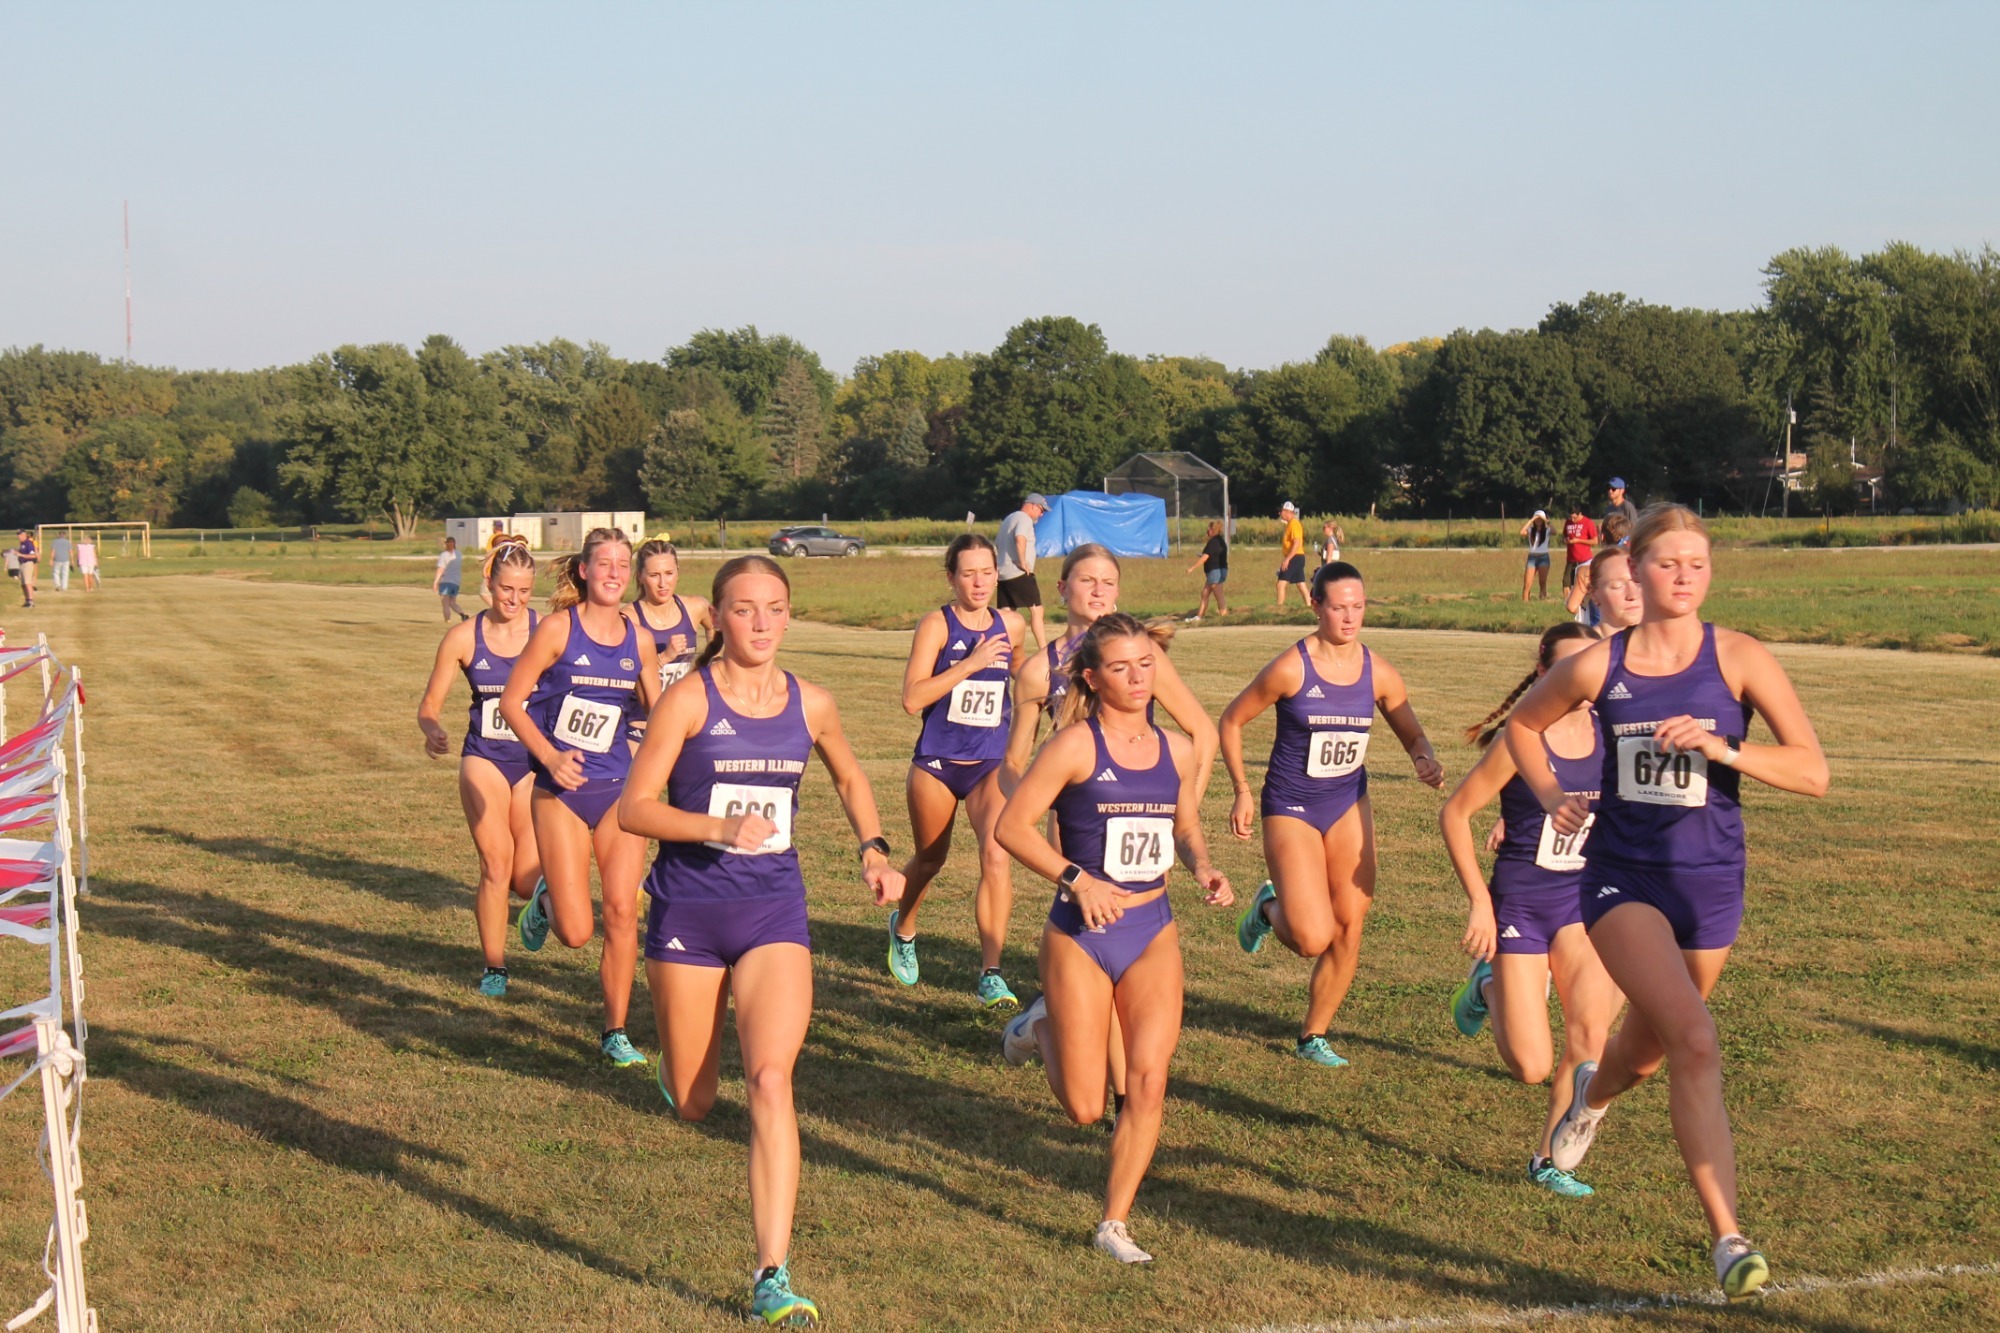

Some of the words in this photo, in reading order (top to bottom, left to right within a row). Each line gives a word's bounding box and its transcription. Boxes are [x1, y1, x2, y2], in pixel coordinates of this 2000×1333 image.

[571, 675, 609, 687] WESTERN
[477, 684, 506, 693] WESTER
[961, 690, 996, 715] 675
[567, 709, 610, 739] 667
[1308, 714, 1347, 725] WESTERN
[710, 728, 736, 736] adidas
[1612, 720, 1665, 737] WESTER
[1320, 740, 1359, 766] 665
[713, 759, 765, 772] WESTERN
[1634, 750, 1692, 790] 670
[1637, 789, 1688, 800] LAKESHORE
[1097, 803, 1145, 813] WESTERN
[1120, 831, 1162, 866] 674
